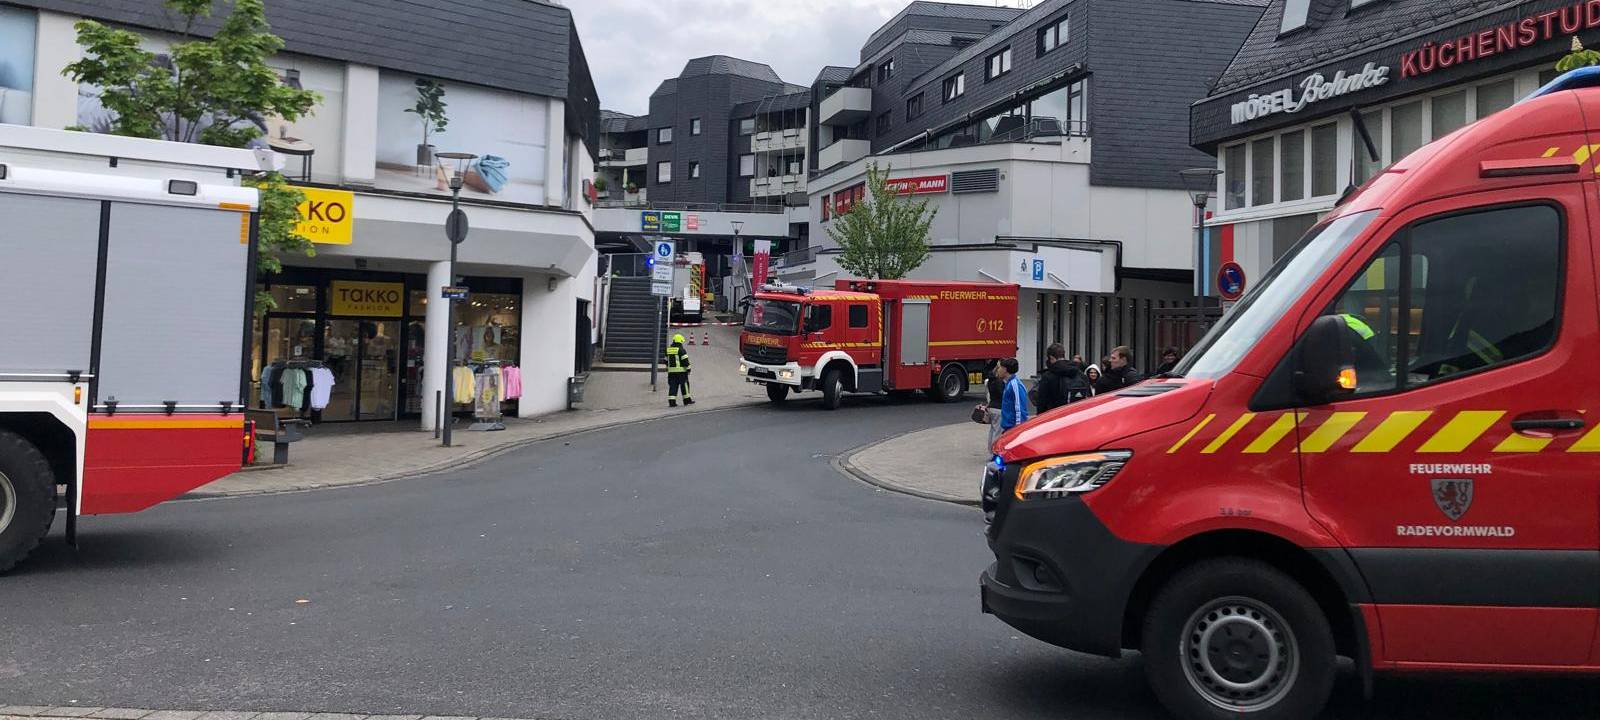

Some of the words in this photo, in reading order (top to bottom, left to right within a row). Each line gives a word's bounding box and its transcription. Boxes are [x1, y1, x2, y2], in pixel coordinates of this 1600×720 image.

[1231, 88, 1297, 125] MÖBEL
[1284, 61, 1390, 113] Behnke
[919, 179, 945, 189] MANN
[940, 290, 987, 300] FEUERWEHR
[346, 304, 390, 312] FASHION
[988, 320, 1004, 331] 112
[747, 334, 779, 344] FEUERWEHR
[1409, 463, 1492, 474] FEUERWEHR
[1396, 525, 1516, 538] RADEVORMWALD
